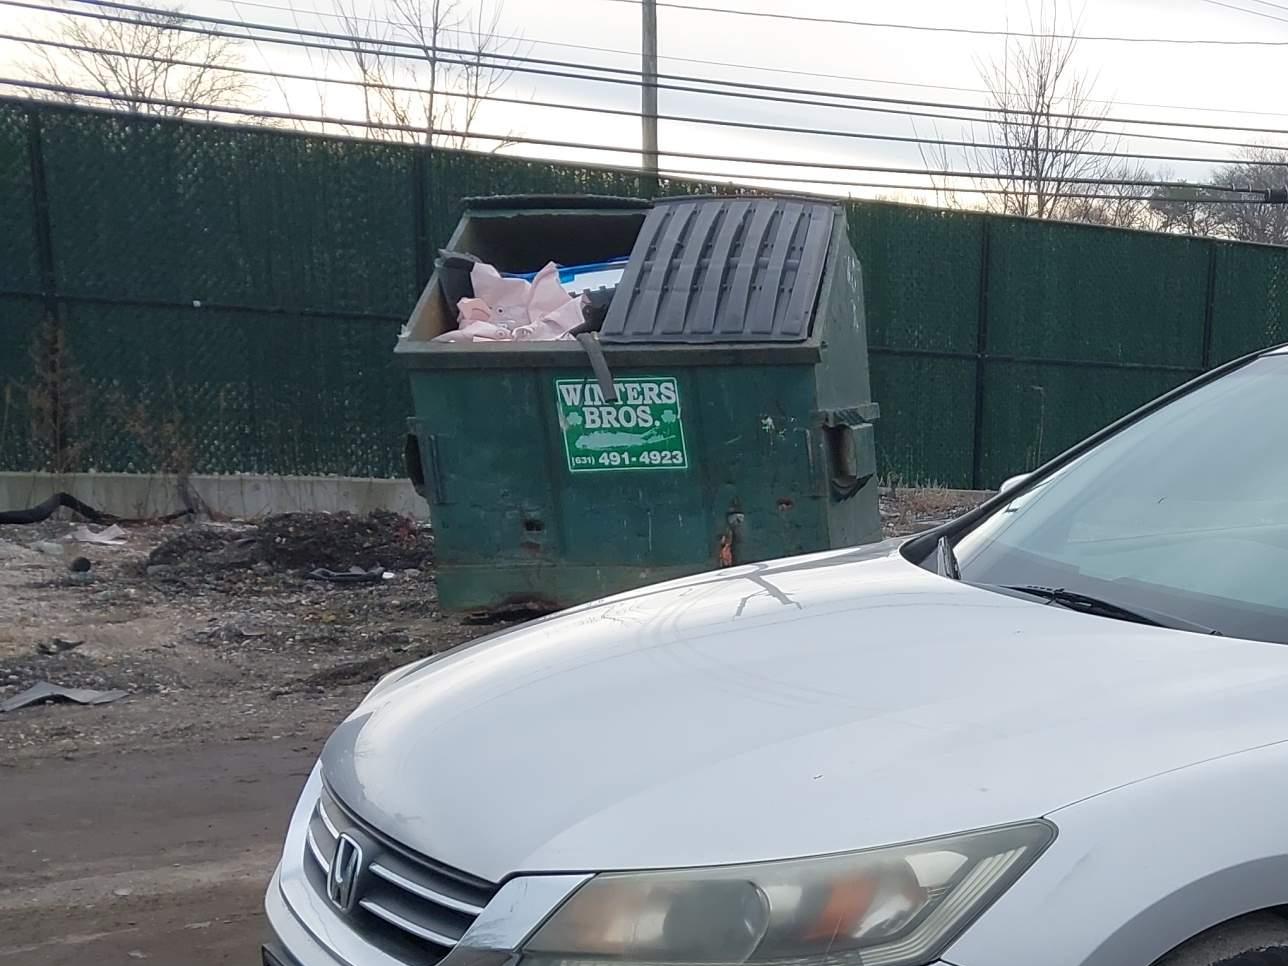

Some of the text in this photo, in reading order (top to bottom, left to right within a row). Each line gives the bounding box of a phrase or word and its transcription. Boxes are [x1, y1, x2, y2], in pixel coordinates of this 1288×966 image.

[582, 406, 660, 428] BROS.
[571, 450, 683, 466] (631) 491-4923
